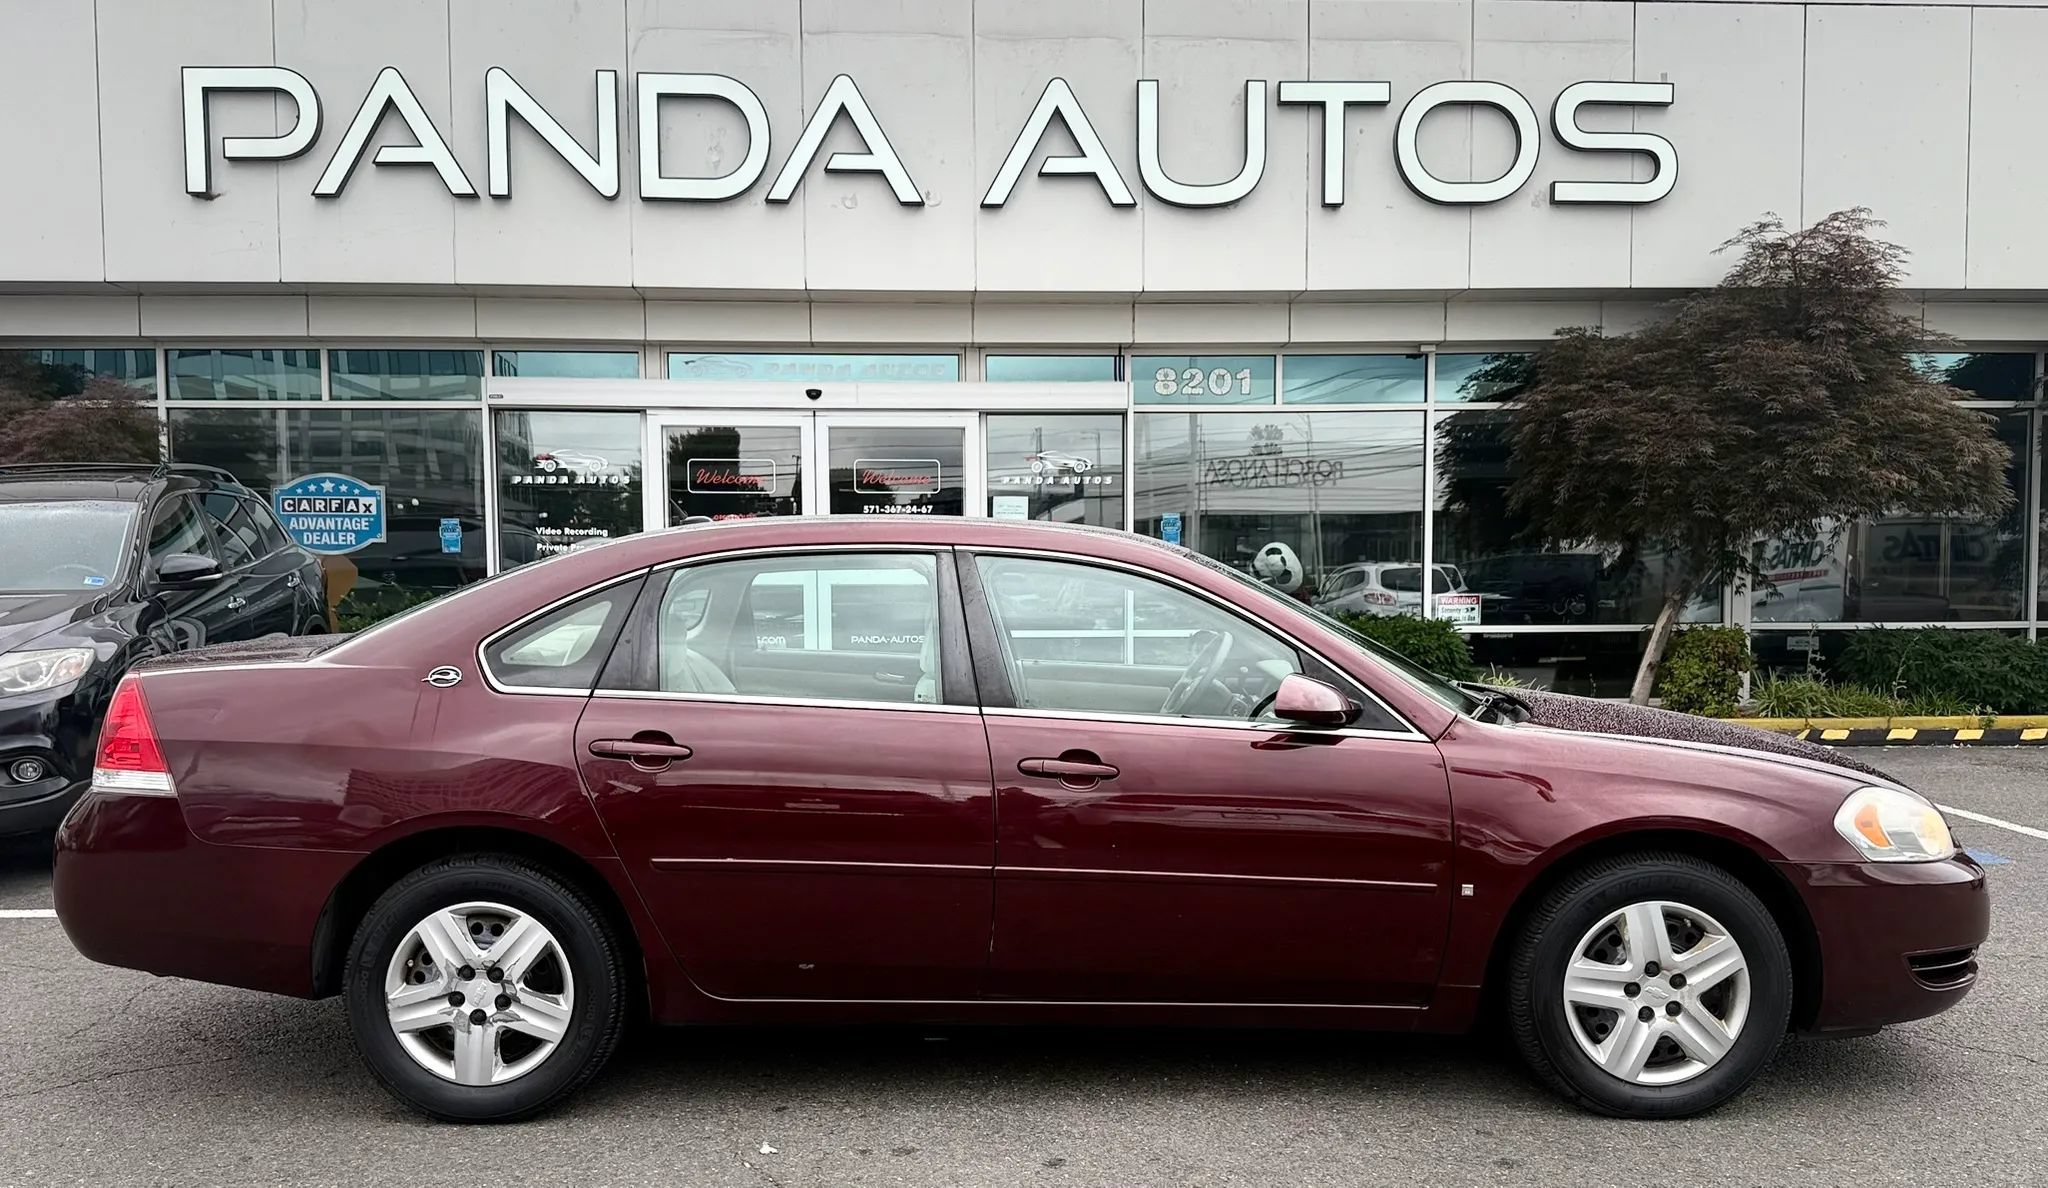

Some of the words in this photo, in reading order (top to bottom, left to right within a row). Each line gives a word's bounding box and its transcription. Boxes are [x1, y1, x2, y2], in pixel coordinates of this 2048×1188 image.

[181, 66, 924, 207] PANDA
[980, 77, 1678, 208] AUTOS
[1154, 367, 1251, 396] 8201
[511, 475, 569, 485] PANDA
[574, 475, 631, 485] AUTOS
[696, 468, 768, 484] Welcome
[862, 469, 929, 485] Welcome
[1001, 475, 1055, 485] PANDA
[1062, 475, 1113, 485] AUTOS
[282, 498, 374, 514] CARFAX
[863, 505, 933, 514] 571-367-24-67
[289, 517, 369, 530] ADVANTAGE
[535, 527, 562, 536] Video
[564, 527, 609, 537] Recording
[303, 532, 356, 545] DEALER
[536, 543, 567, 551] Private
[1440, 596, 1478, 605] WARNING
[850, 635, 925, 644] PANDA-AUTOS
